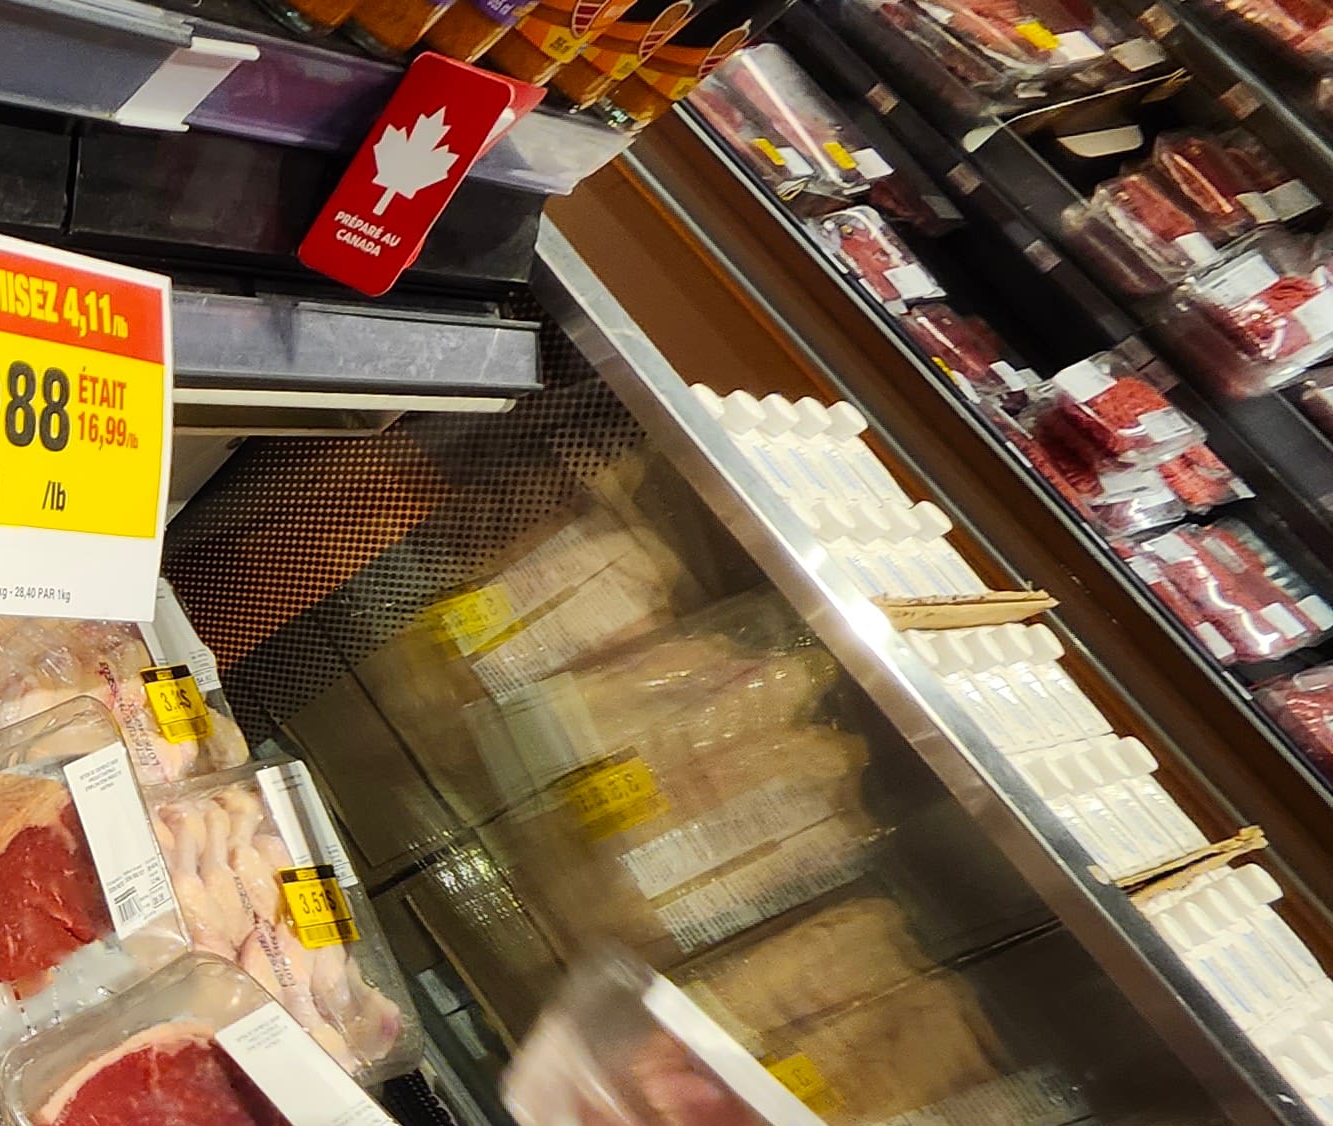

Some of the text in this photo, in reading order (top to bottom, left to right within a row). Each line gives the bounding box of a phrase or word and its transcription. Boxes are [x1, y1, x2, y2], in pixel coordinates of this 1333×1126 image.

[335, 211, 401, 248] PRÉPARÉ AU
[335, 229, 382, 256] CANADA
[78, 367, 127, 411] ÉTAIT
[42, 480, 66, 511] /lb
[15, 586, 36, 599] 28,40
[38, 588, 55, 599] PAR
[58, 589, 71, 603] 1kg
